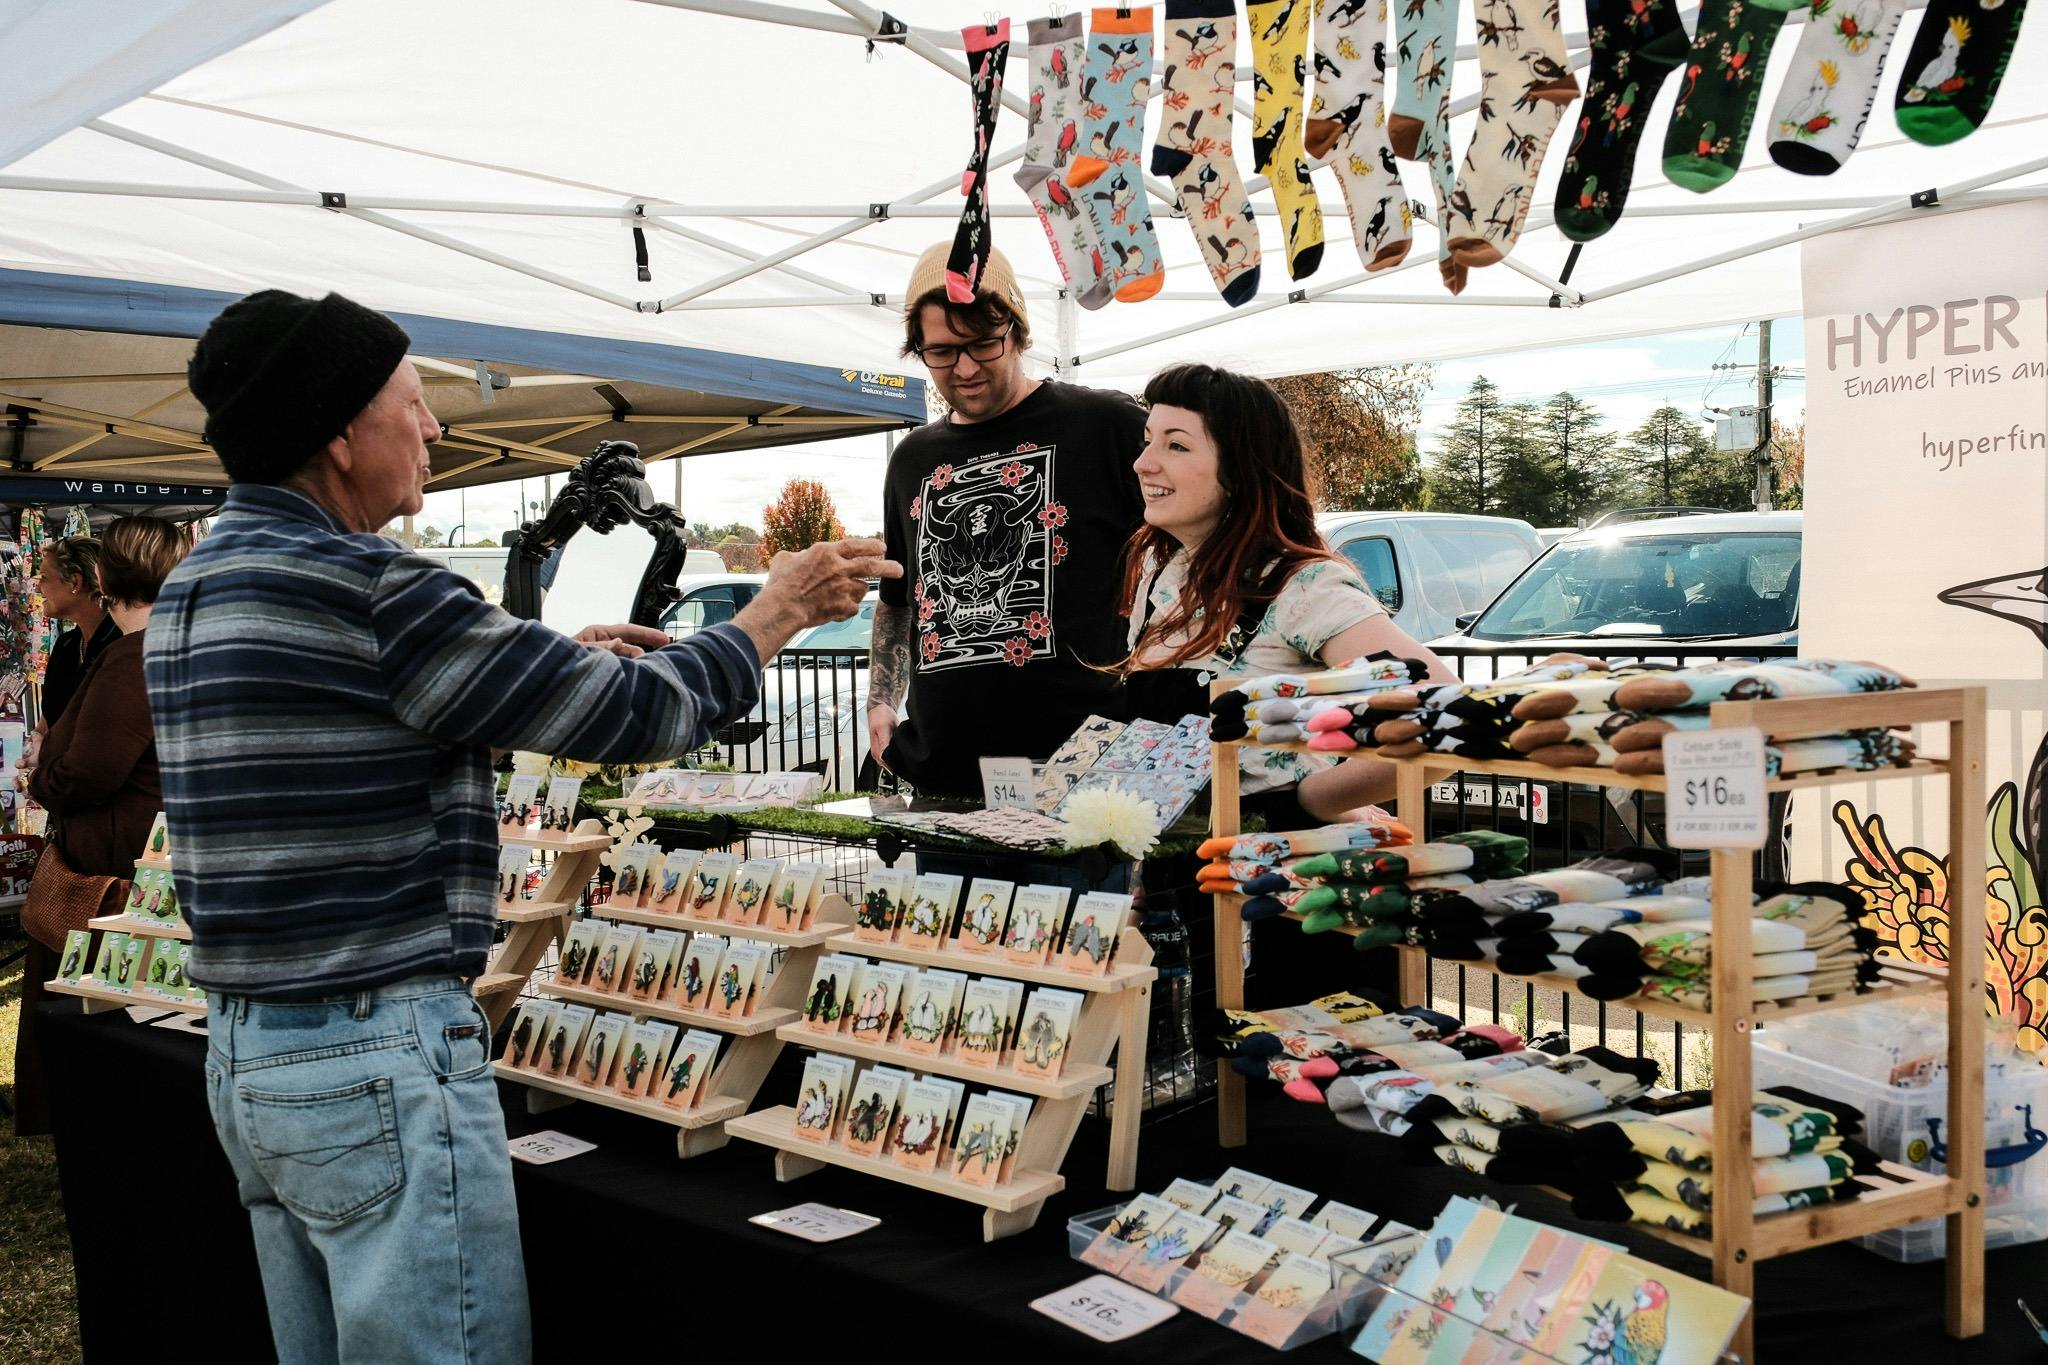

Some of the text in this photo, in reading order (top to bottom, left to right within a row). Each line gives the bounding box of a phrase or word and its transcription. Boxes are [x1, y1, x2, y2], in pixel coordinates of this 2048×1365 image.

[1827, 294, 2020, 371] HYPER
[1843, 366, 1935, 398] Enamel
[1944, 364, 2001, 387] Pins
